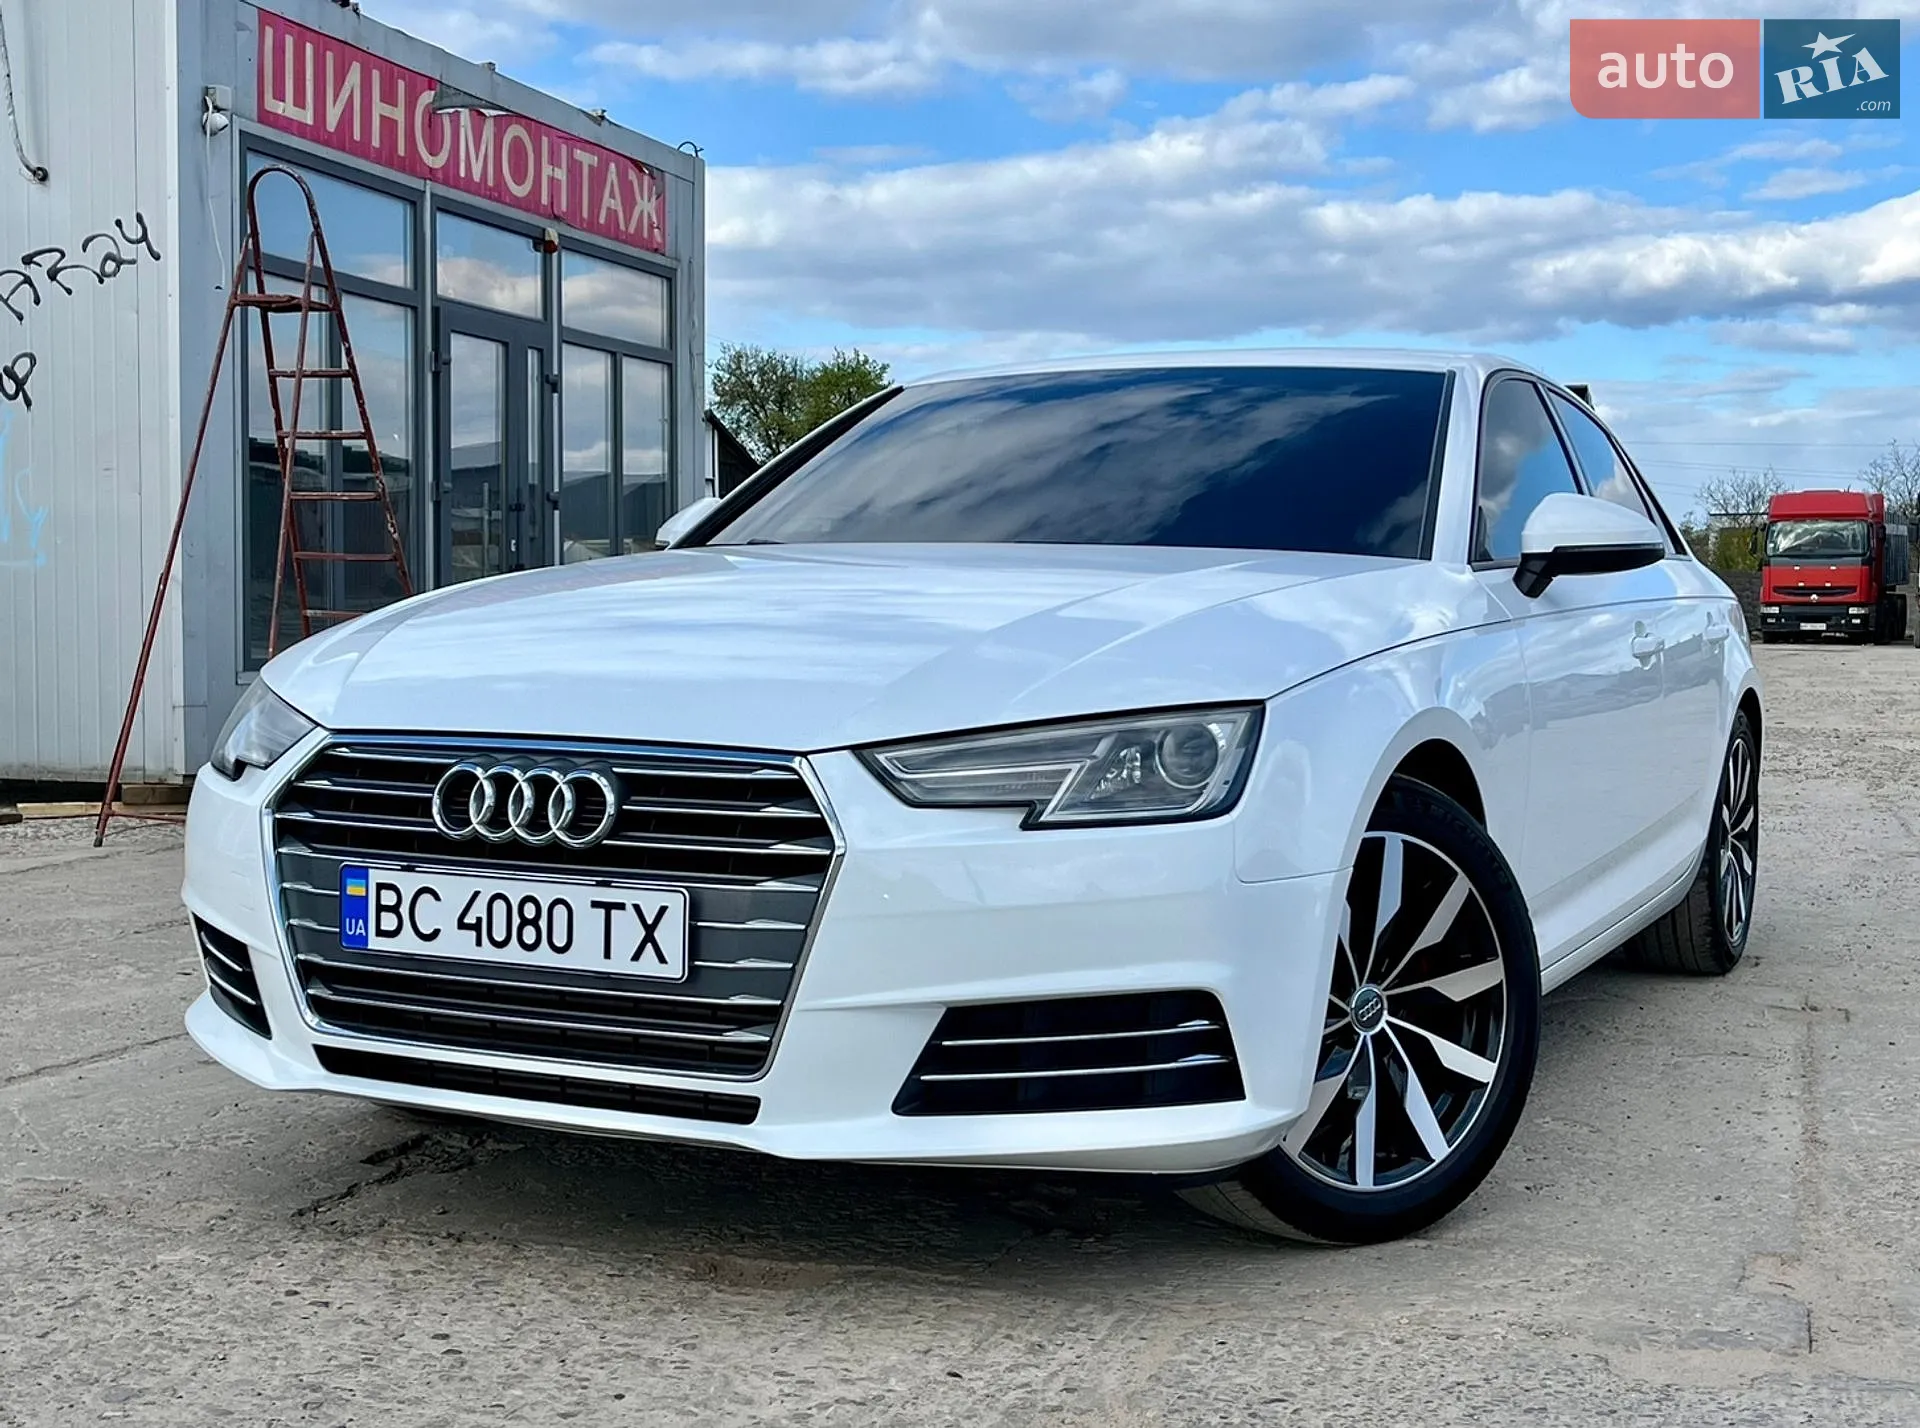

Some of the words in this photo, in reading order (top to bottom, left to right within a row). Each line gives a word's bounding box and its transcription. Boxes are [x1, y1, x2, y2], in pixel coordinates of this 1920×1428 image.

[263, 25, 664, 244] ШИНОМОНТАЖ
[345, 917, 367, 937] UA
[374, 881, 442, 942] BC
[456, 889, 574, 955] 4080
[590, 899, 669, 965] TX
